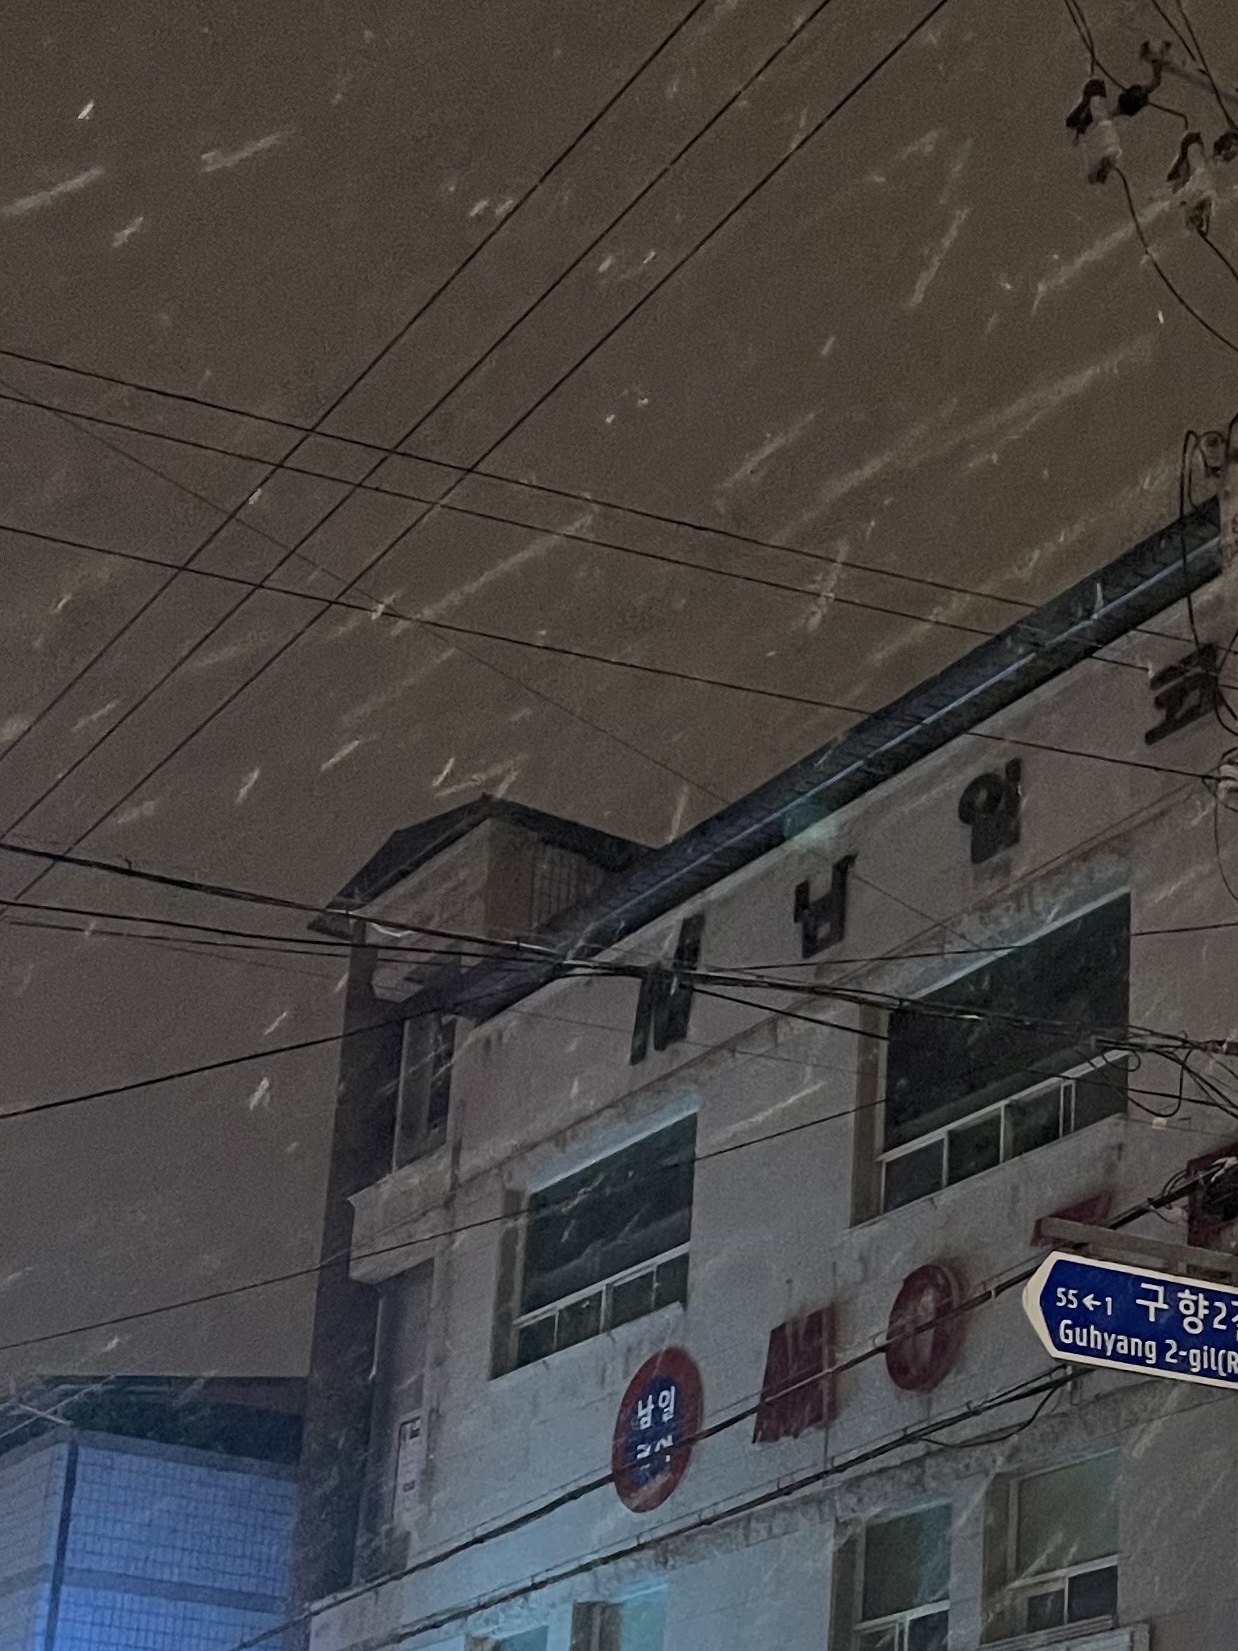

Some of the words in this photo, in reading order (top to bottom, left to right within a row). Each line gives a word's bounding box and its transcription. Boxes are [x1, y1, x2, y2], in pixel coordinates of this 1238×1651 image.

[1056, 1288, 1078, 1309] 55
[1105, 1296, 1113, 1316] 1
[1059, 1319, 1157, 1364] Guhyang
